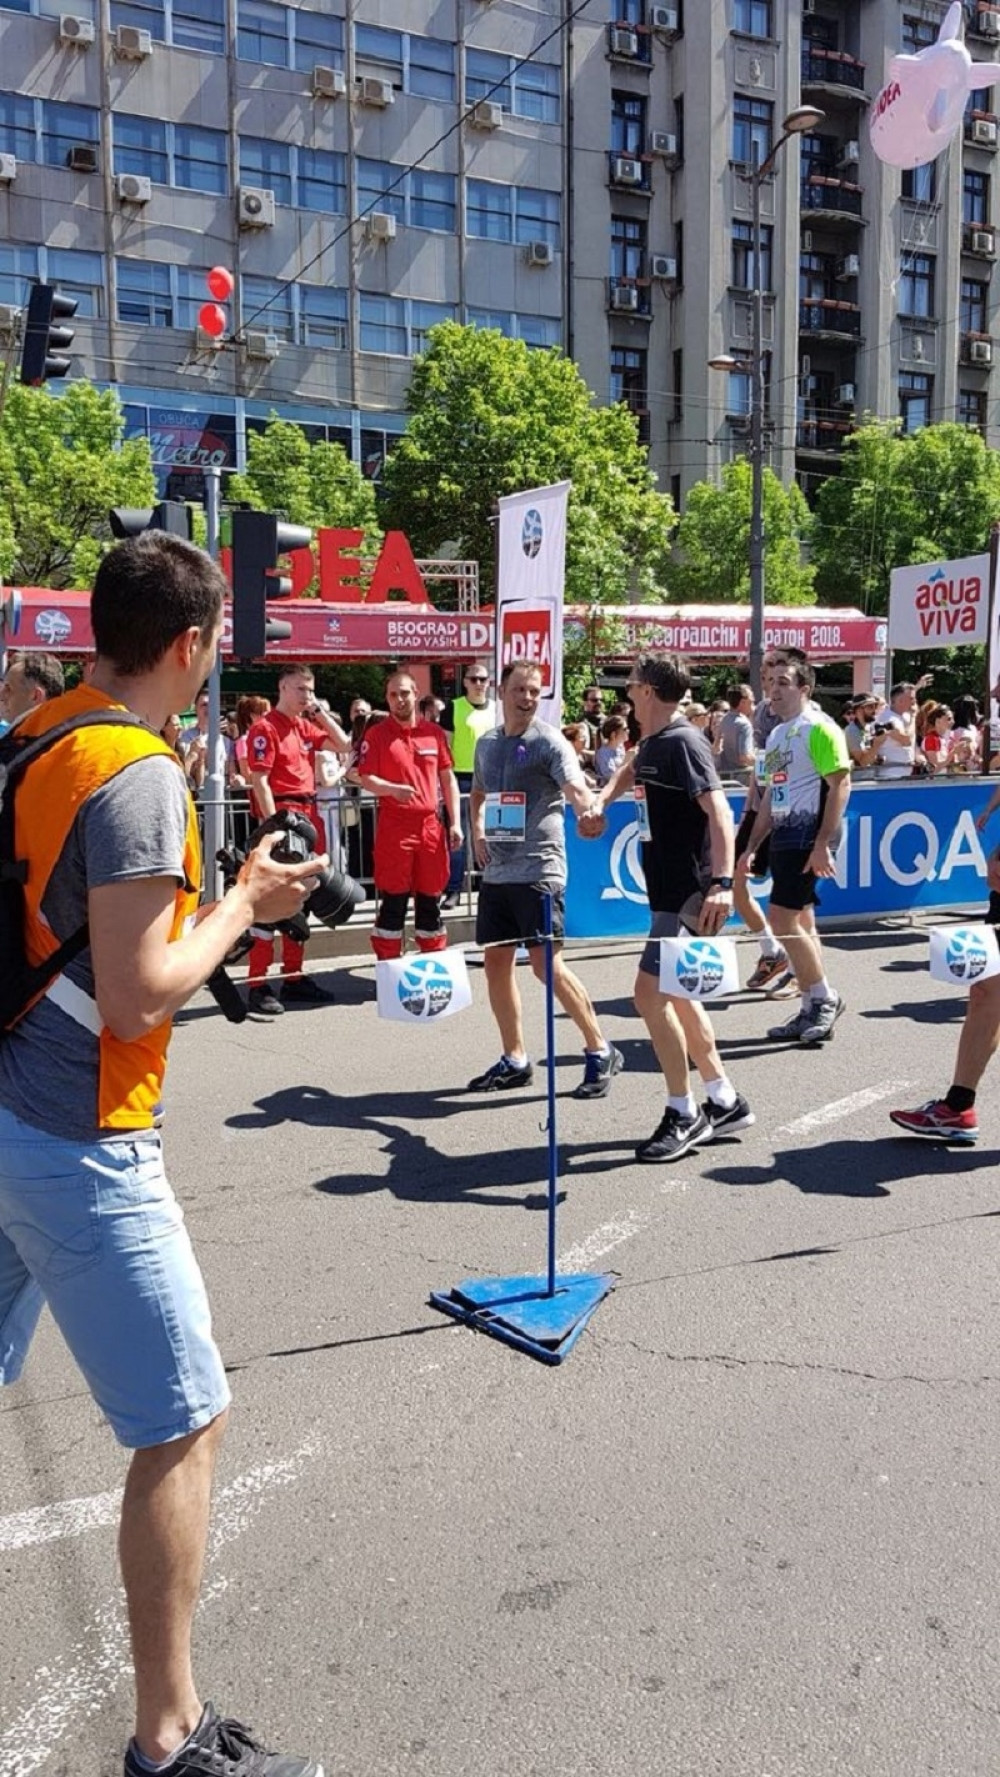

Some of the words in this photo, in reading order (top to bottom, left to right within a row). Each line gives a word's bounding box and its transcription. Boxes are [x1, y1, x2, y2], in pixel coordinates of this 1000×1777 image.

[130, 430, 226, 466] Metro
[915, 576, 981, 610] aqua
[387, 621, 458, 635] BEOGRAD
[920, 605, 976, 636] viva
[387, 636, 421, 647] GRAD
[424, 634, 458, 648] VAŠIH
[810, 625, 846, 647] 2018.
[496, 808, 502, 825] 1
